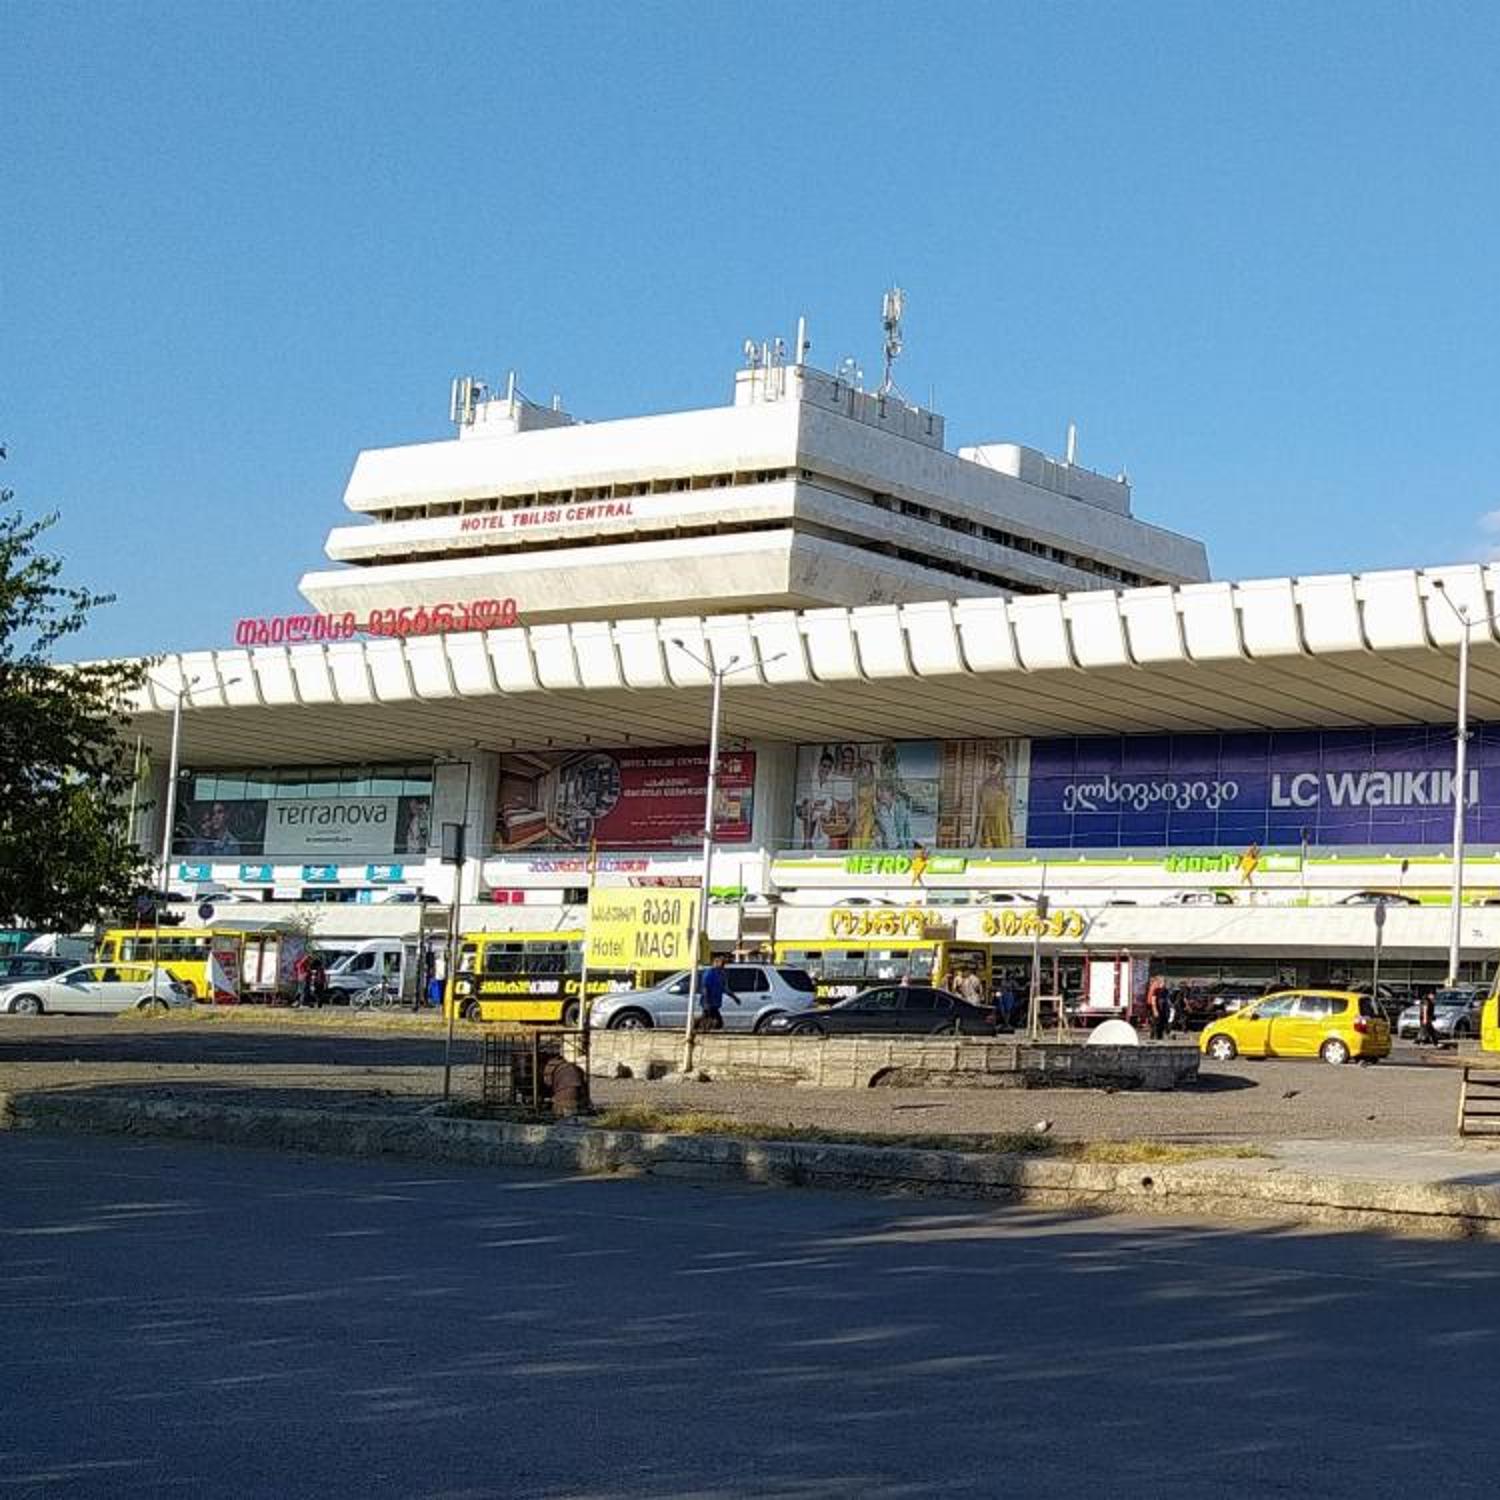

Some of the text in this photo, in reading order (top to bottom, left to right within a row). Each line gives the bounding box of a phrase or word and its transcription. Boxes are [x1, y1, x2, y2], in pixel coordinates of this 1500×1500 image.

[460, 502, 633, 531] HOTEL TBILISI CENTRAL
[235, 612, 356, 646] თბილისი
[1063, 775, 1239, 811] ელსივაიკიკი
[1271, 773, 1319, 806] LC
[846, 854, 911, 874] METRO
[591, 930, 681, 959] Hotel MAGI
